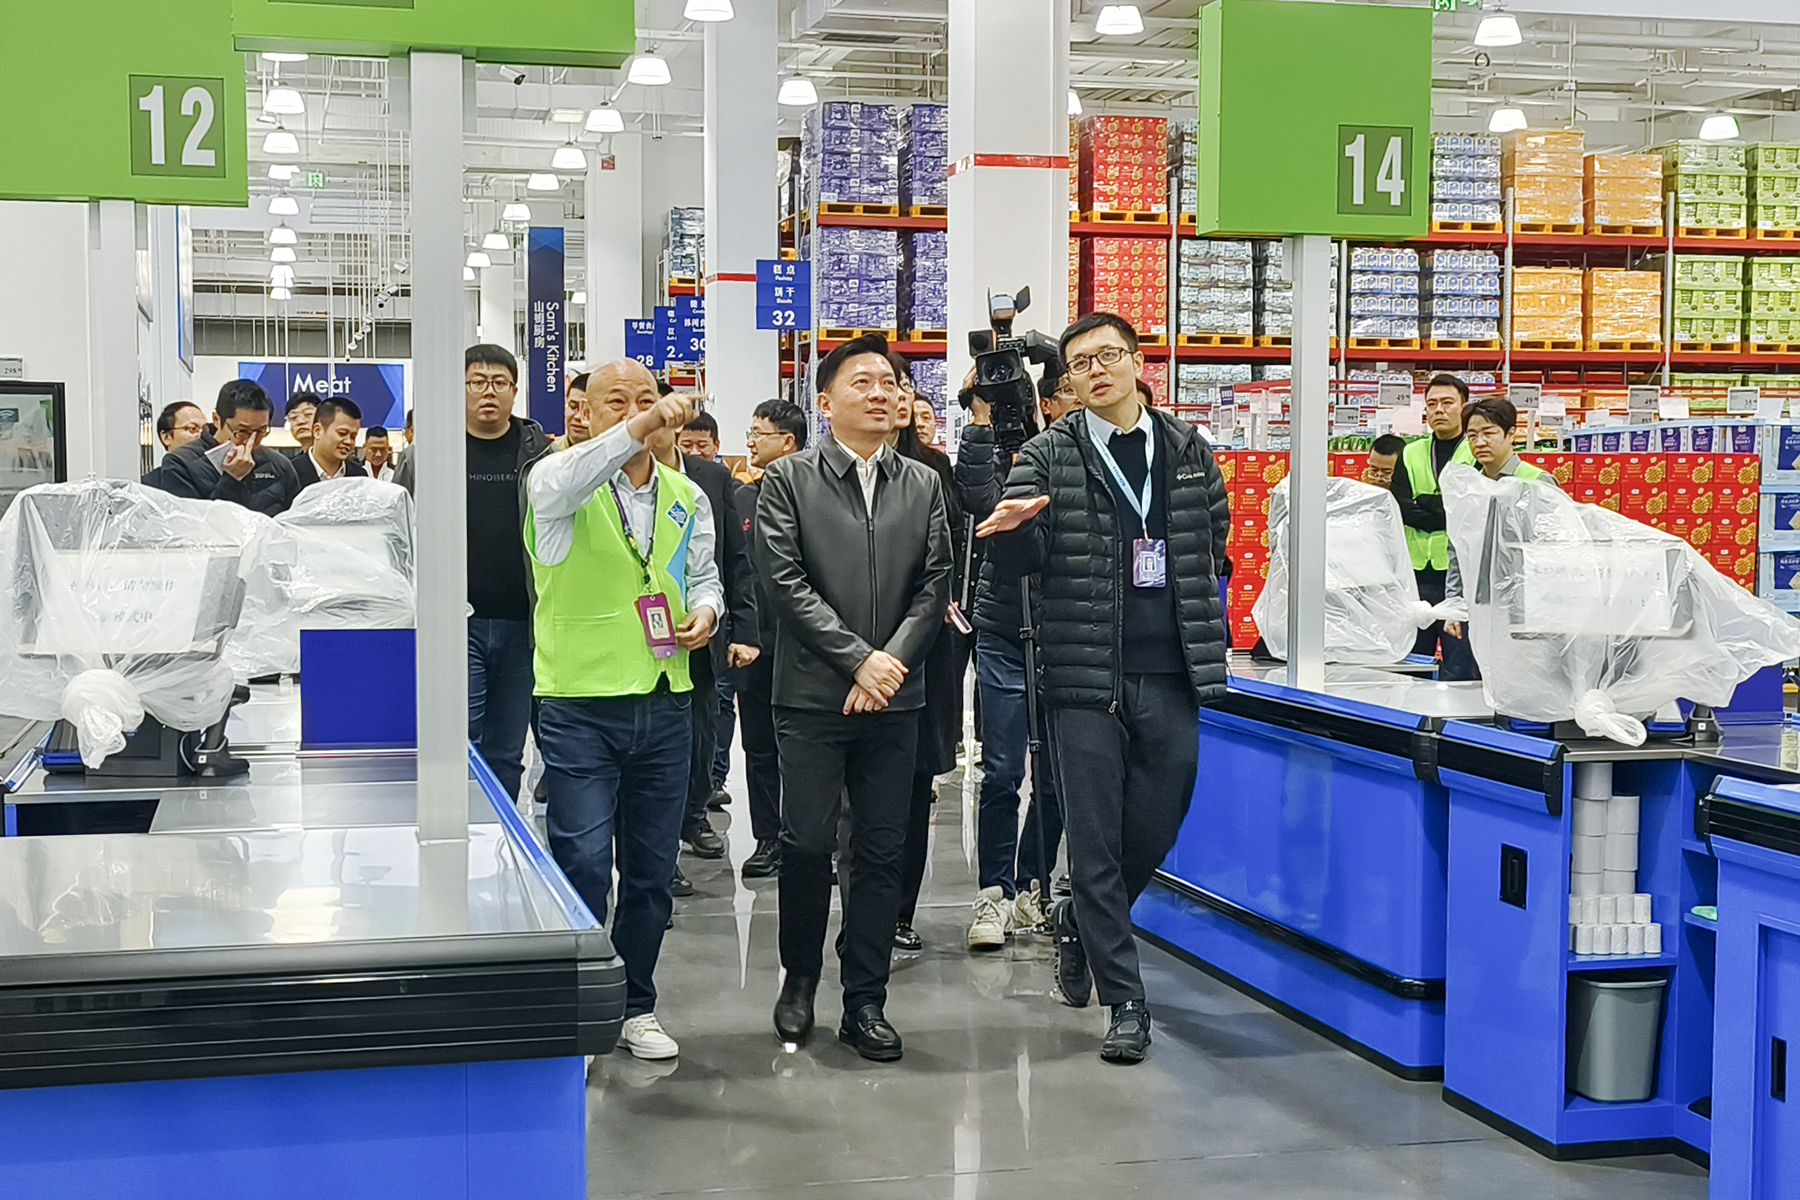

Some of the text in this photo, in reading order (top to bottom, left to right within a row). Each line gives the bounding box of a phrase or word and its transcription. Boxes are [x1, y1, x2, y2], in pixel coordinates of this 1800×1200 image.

[139, 85, 216, 167] 12
[1345, 133, 1405, 206] 14
[533, 300, 545, 349] 山姆厨房
[772, 310, 796, 326] 32
[546, 301, 560, 393] Sam's Kitchen
[636, 355, 654, 366] 28
[293, 372, 352, 394] Meat
